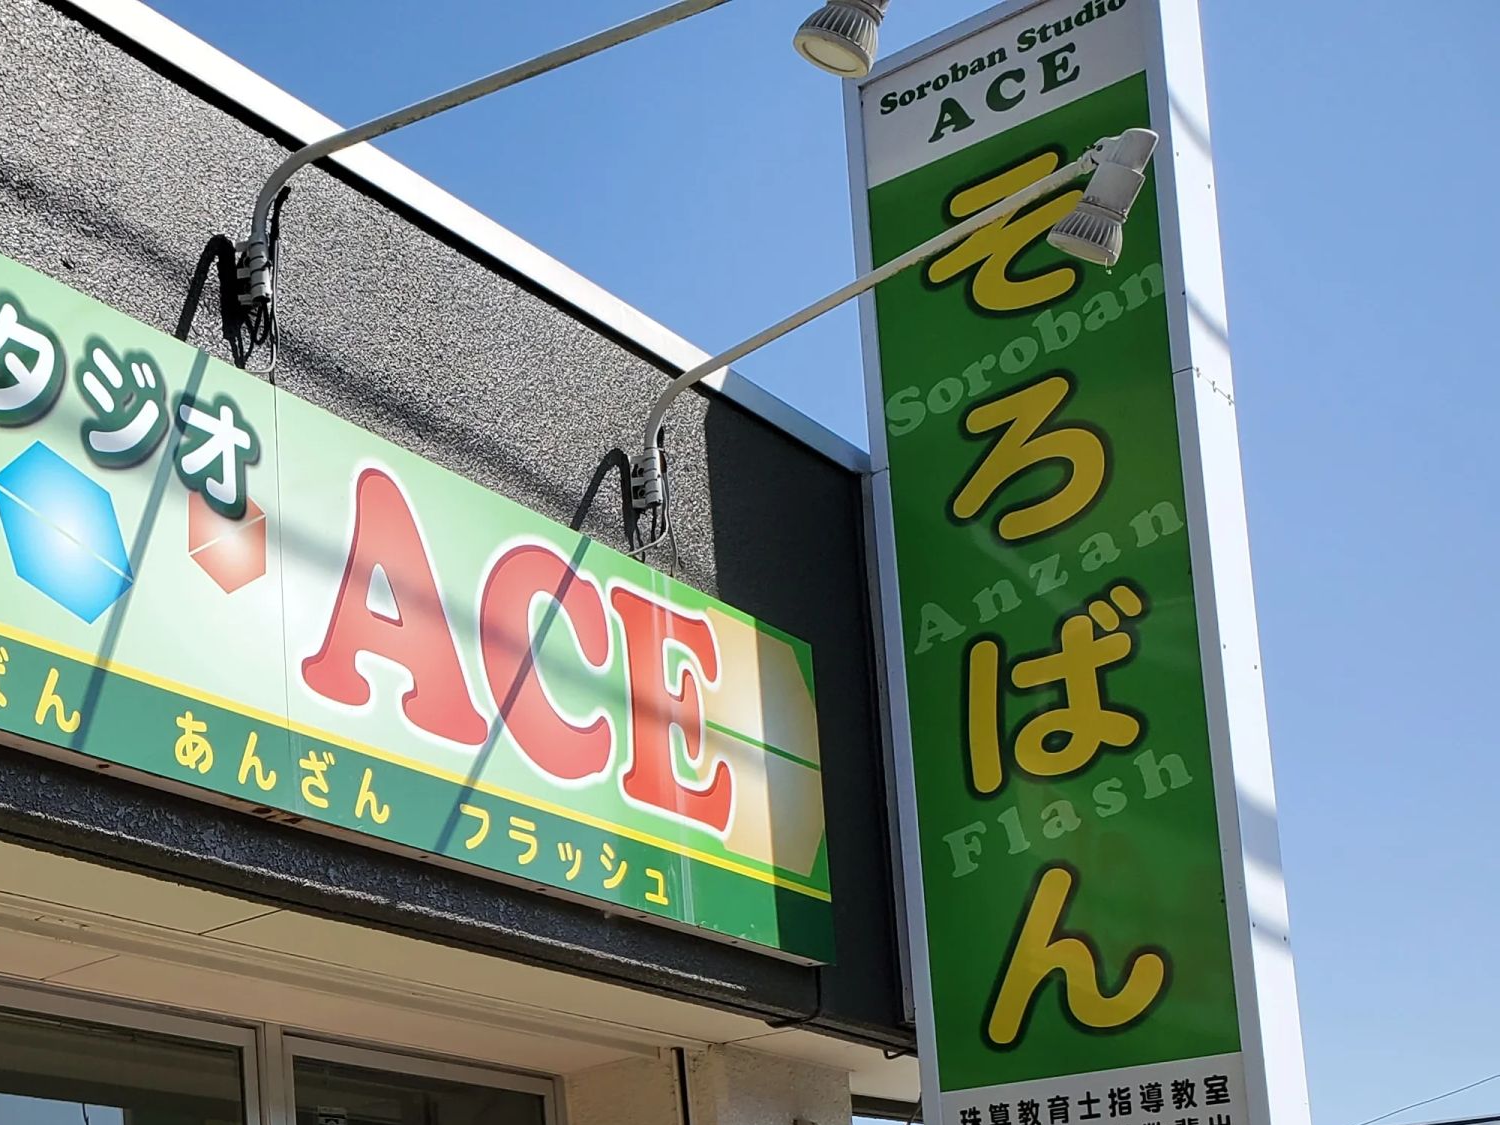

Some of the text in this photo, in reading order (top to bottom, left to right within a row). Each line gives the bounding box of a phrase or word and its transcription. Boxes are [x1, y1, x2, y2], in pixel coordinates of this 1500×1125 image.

[879, 0, 1126, 116] Soroban Studio
[928, 43, 1081, 143] ACE
[885, 262, 1166, 437] Soroban
[300, 466, 733, 833] ACE
[914, 501, 1184, 654] Anzan
[927, 151, 1164, 1044] そろばん
[174, 711, 390, 825] あんざん
[460, 803, 670, 906] フラッシュ
[942, 749, 1194, 878] Flash
